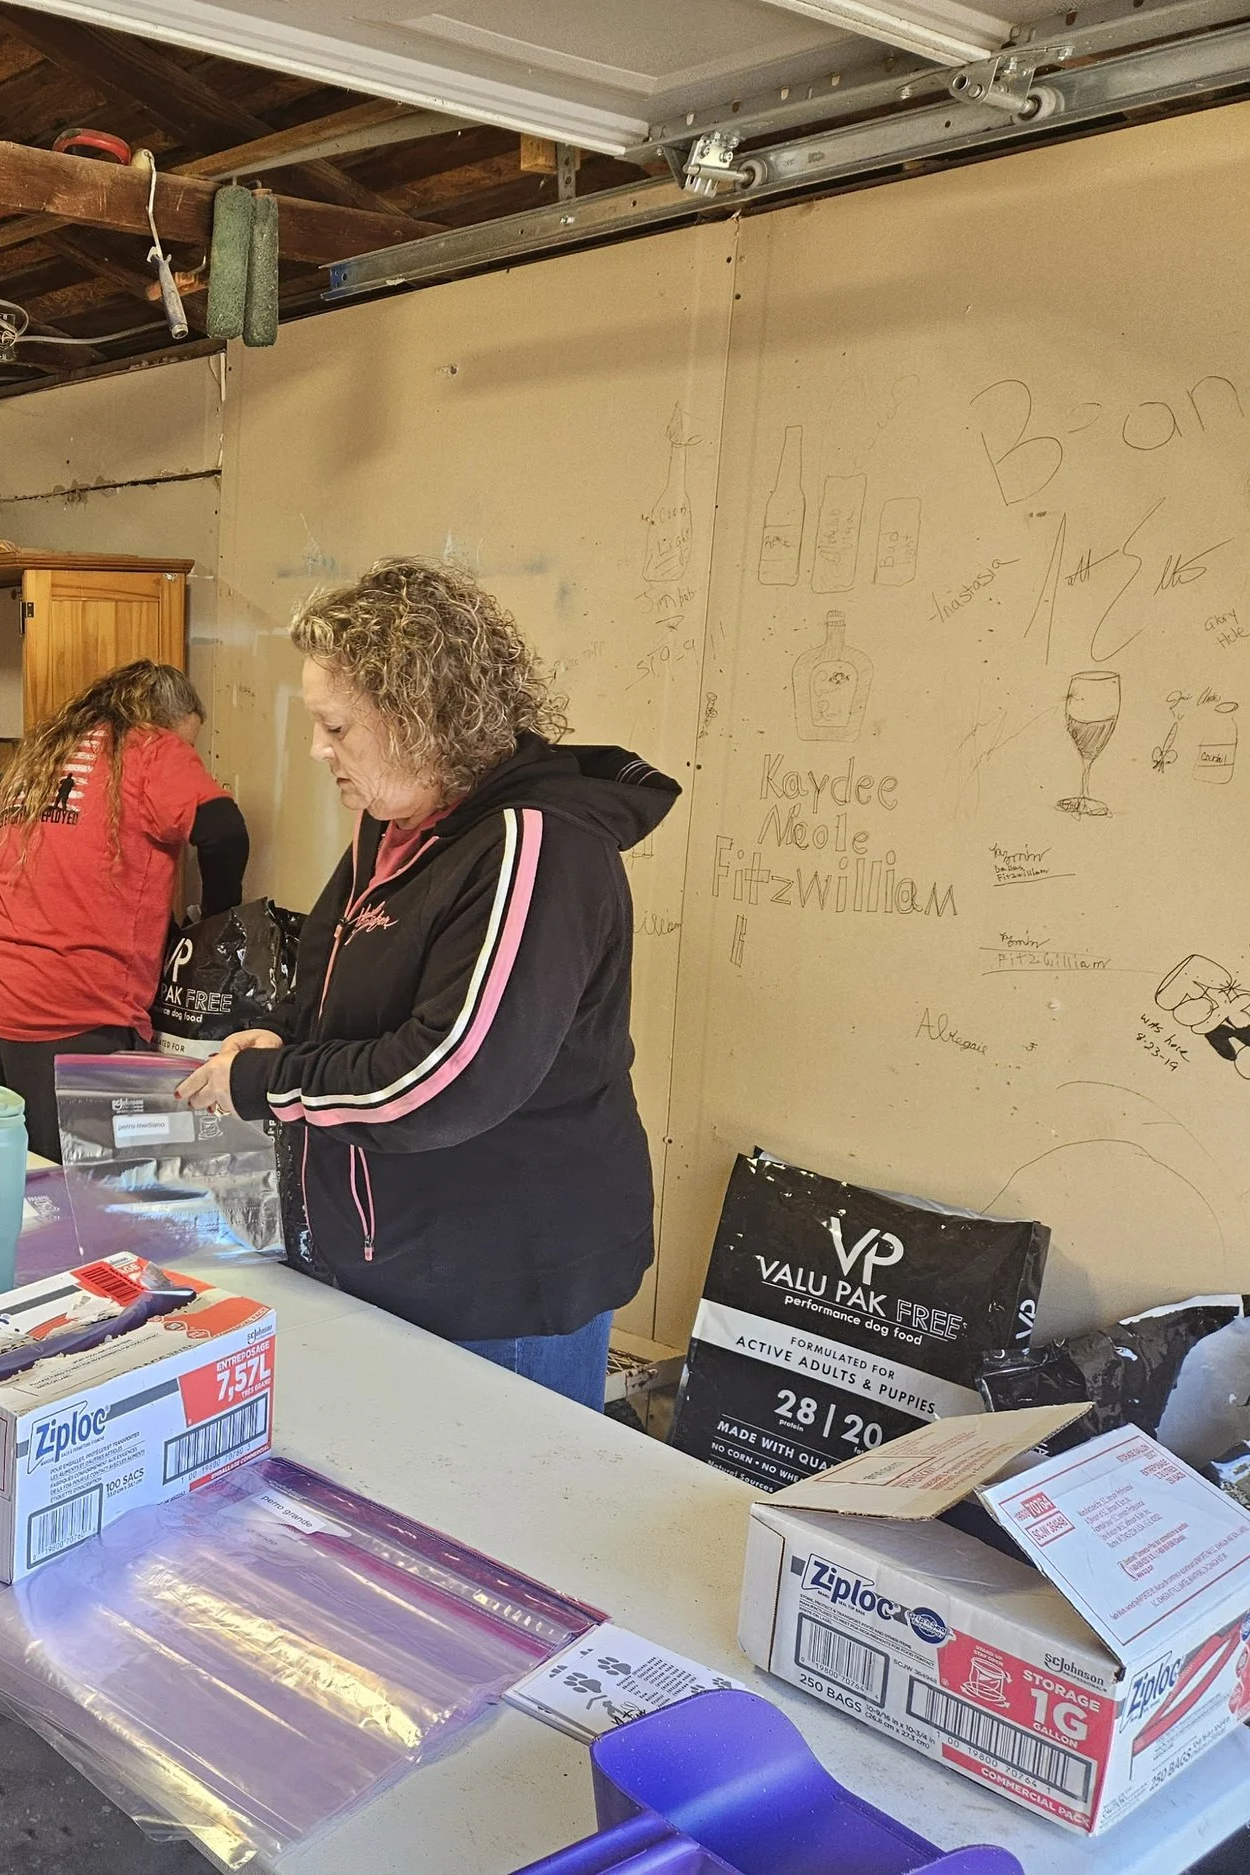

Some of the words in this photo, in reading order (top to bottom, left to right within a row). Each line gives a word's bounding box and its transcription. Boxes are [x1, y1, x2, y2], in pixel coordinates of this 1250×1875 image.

[879, 531, 899, 568] Bud
[760, 753, 899, 814] Kaydee
[40, 811, 80, 825] EPLOYED
[184, 1011, 203, 1023] food
[185, 989, 233, 1013] FREE
[1136, 1032, 1179, 1072] 8-23-19
[830, 1217, 904, 1286] VP
[758, 1255, 827, 1297] VALU
[835, 1280, 887, 1317] PAK
[896, 1299, 962, 1340] FREE
[785, 1295, 861, 1325] performance
[865, 1319, 888, 1337] dog
[894, 1325, 922, 1345] food
[216, 1341, 270, 1372] ENTREPOSAGE
[736, 1336, 792, 1362] ACTIVE
[798, 1356, 856, 1384] ADULTS
[863, 1379, 872, 1390] &
[879, 1384, 935, 1414] PUPPIES
[790, 1336, 867, 1372] FORMULATED
[872, 1365, 895, 1380] FOR
[217, 1354, 272, 1402] 7,57L
[36, 1407, 106, 1463] Ziploc
[774, 1389, 818, 1425] 28
[841, 1414, 883, 1448] 20
[779, 1418, 804, 1432] protein
[711, 1442, 724, 1452] NO
[727, 1448, 752, 1464] CORN
[762, 1462, 776, 1474] NO
[717, 1420, 756, 1444] MADE
[761, 1437, 794, 1459] WITH
[106, 1480, 121, 1493] 100
[123, 1468, 145, 1484] SACS
[261, 1495, 284, 1510] perro
[283, 1509, 313, 1528] grande
[1027, 1496, 1054, 1517] 70764
[811, 1560, 895, 1620] Ziploc
[815, 1663, 838, 1679] 19800
[841, 1673, 865, 1691] 70764
[893, 1659, 913, 1671] SCJW
[1044, 1653, 1104, 1686] scJohnson
[800, 1673, 823, 1692] 250
[827, 1686, 862, 1713] BAGS
[1023, 1669, 1100, 1712] STORAGE
[1126, 1657, 1182, 1720] Ziploc
[1030, 1688, 1088, 1741] 1G
[1033, 1722, 1078, 1749] GALLON
[967, 1747, 998, 1767] 19800
[1005, 1764, 1037, 1787] 70764
[981, 1767, 1056, 1812] COMMERCIAL
[1058, 1807, 1090, 1827] PACK
